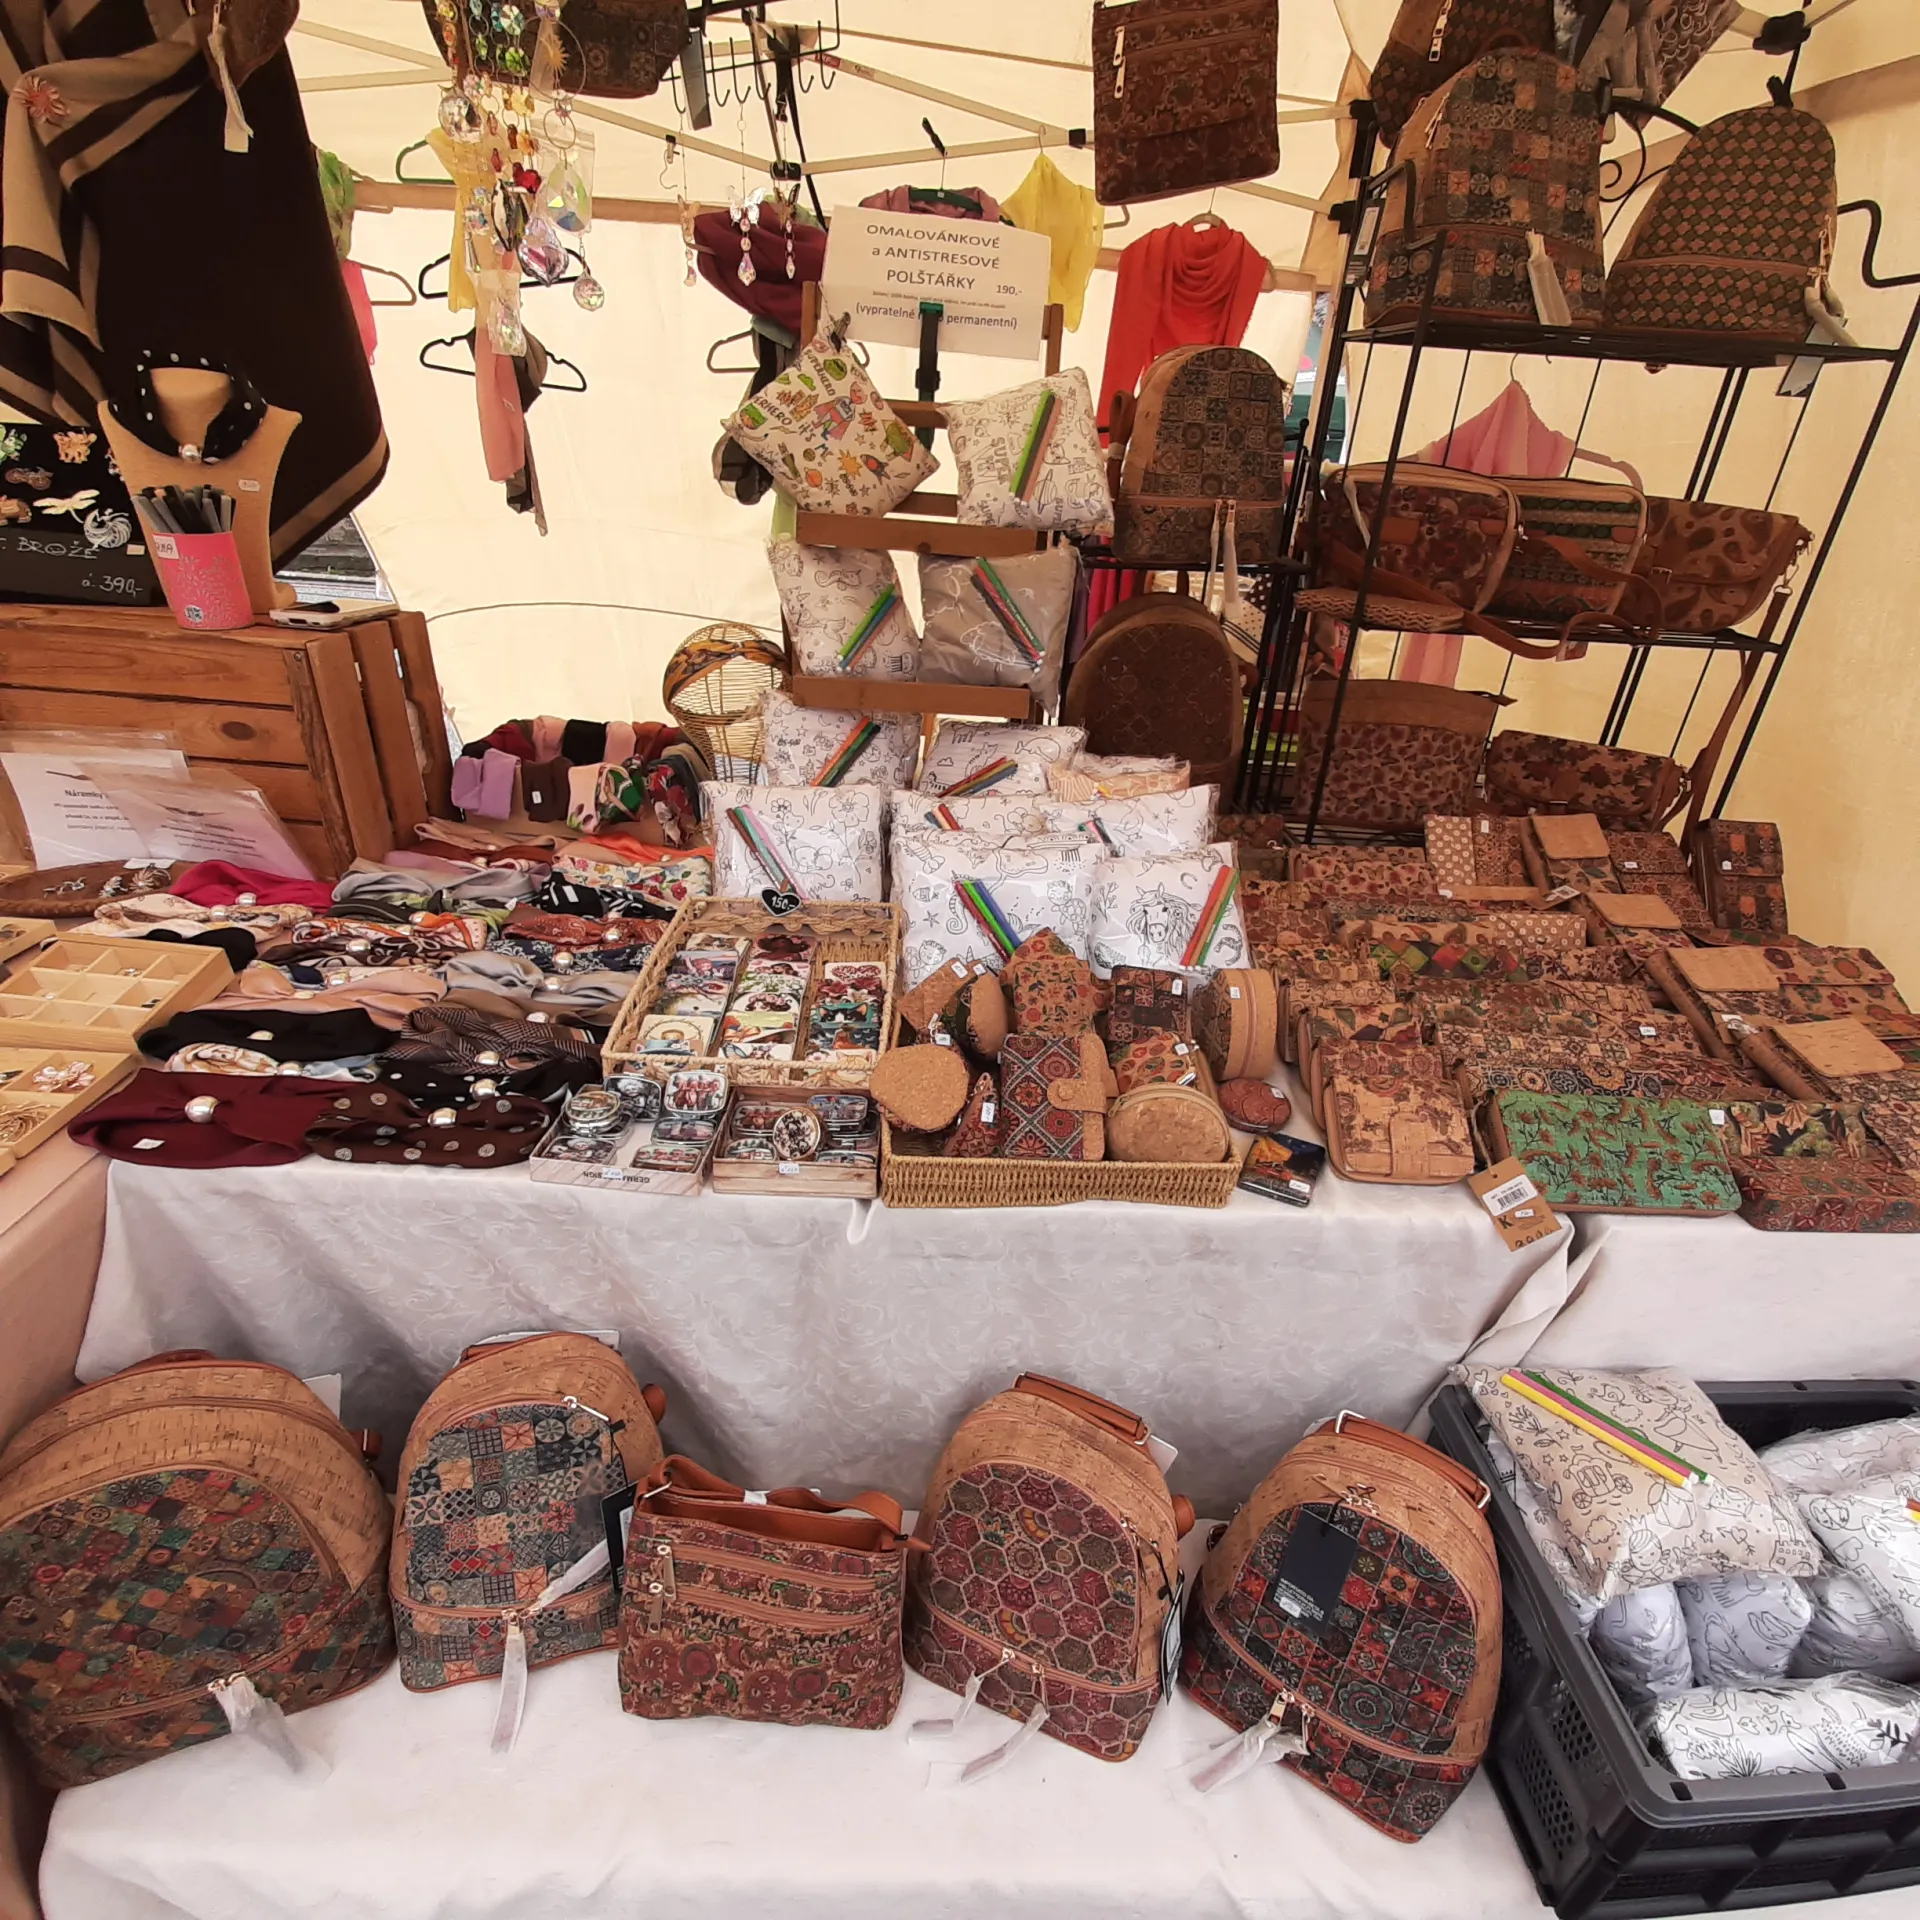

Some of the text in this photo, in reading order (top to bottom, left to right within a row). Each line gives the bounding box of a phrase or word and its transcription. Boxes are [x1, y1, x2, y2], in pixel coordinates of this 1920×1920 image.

[867, 224, 1000, 249] OMALOVÁNKOVÉ
[872, 247, 1000, 269] a ANTISTRESOVÉ
[887, 269, 1022, 296] POLŠTÁŘKY 190,-
[856, 301, 915, 320] (vypratelné
[947, 314, 1017, 330] permanentní)
